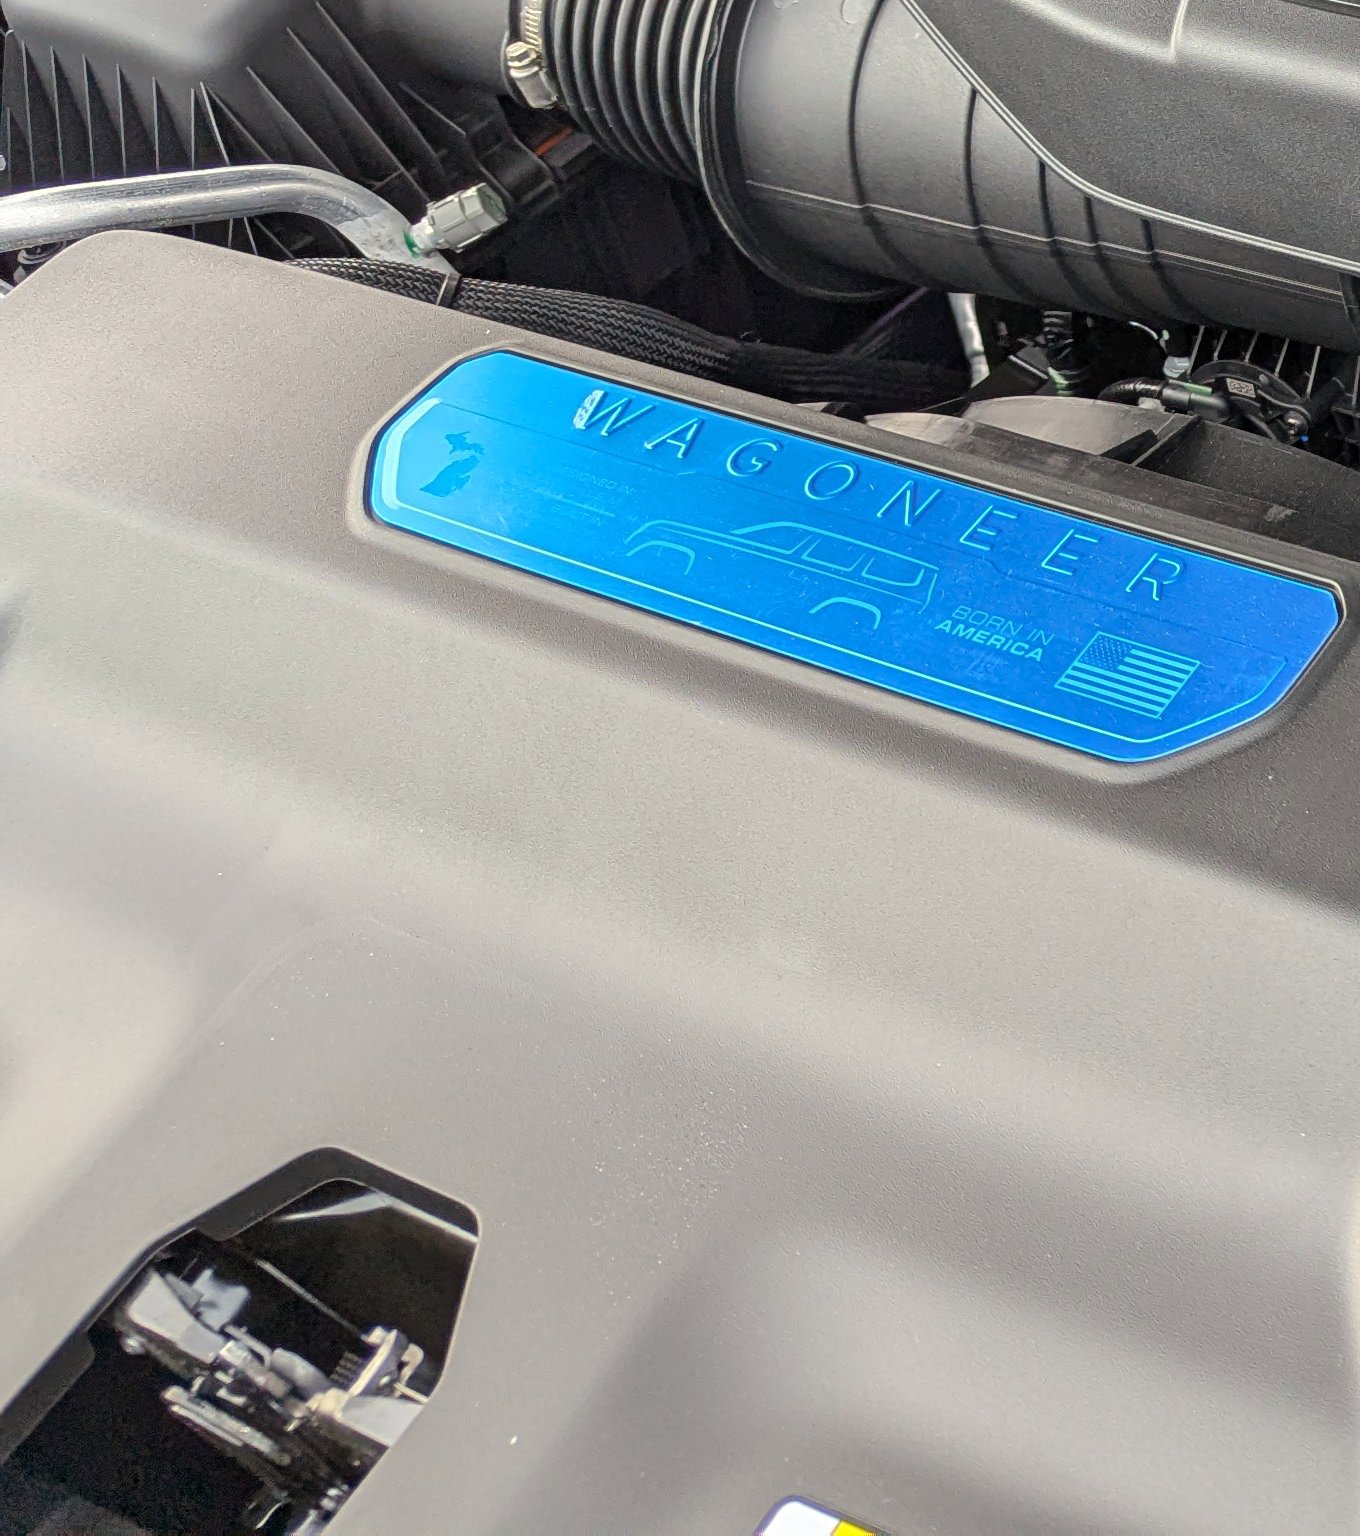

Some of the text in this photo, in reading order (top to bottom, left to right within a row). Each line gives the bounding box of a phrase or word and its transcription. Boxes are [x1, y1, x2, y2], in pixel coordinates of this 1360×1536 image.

[573, 388, 1187, 602] WAGONEER
[935, 619, 1045, 662] AMERICA
[951, 603, 1056, 647] BORN IN
